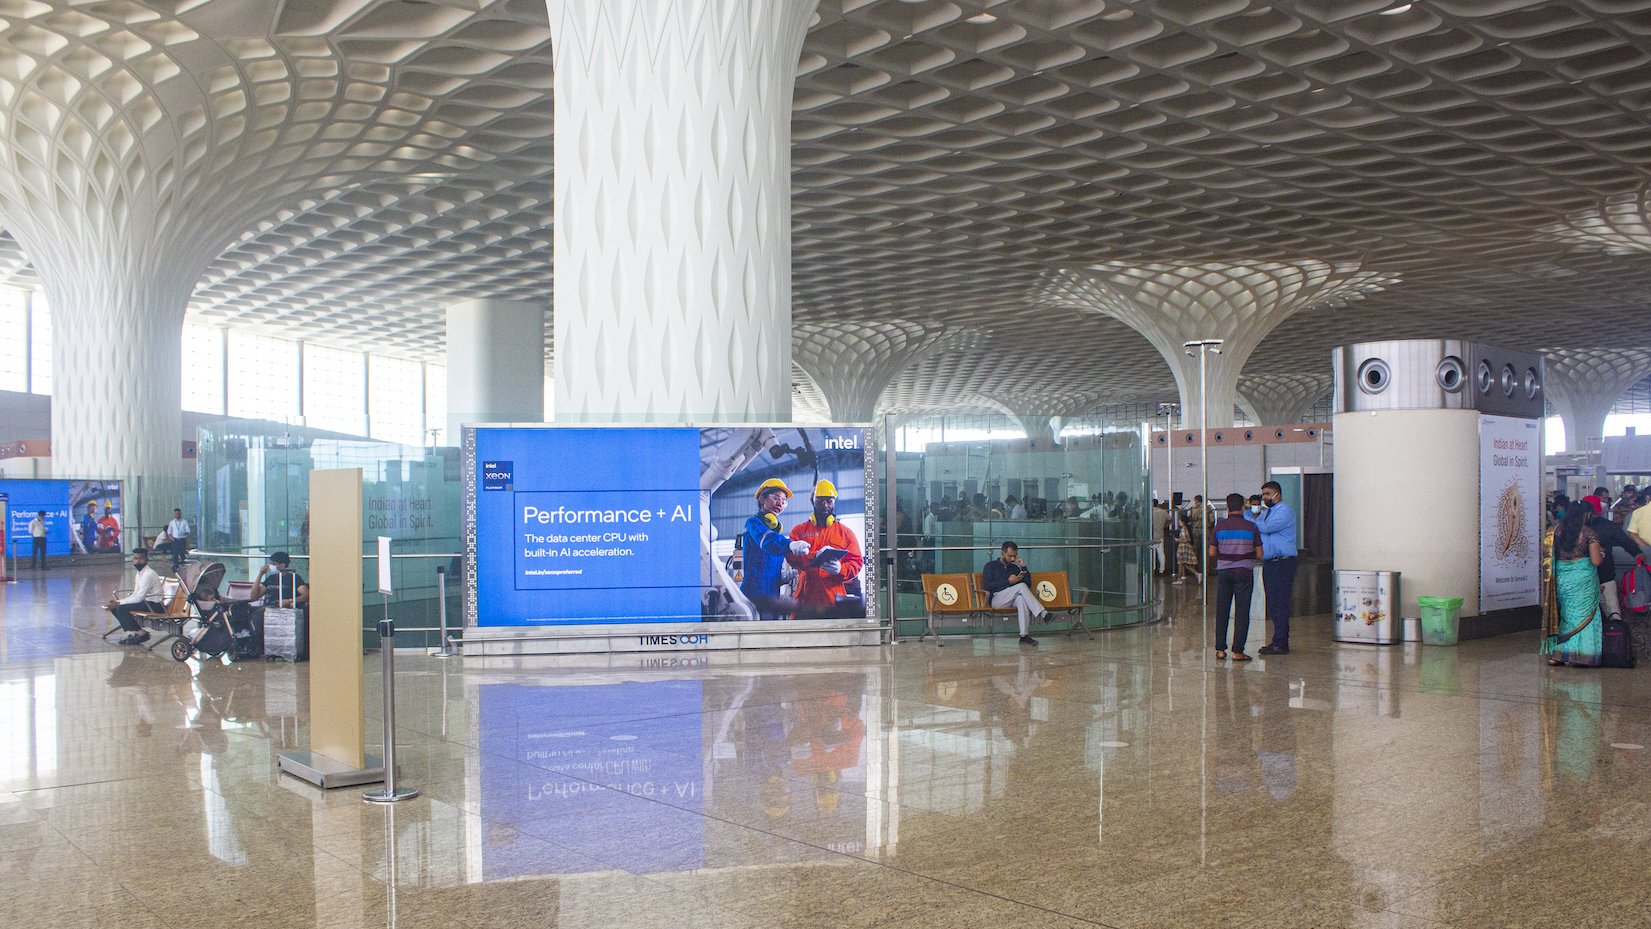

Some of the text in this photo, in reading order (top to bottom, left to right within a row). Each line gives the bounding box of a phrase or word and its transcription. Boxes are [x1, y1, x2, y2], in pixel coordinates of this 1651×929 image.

[1493, 437, 1508, 450] Indian
[1515, 439, 1528, 451] Heart
[1493, 454, 1508, 467] Global
[368, 496, 396, 511] Indian
[409, 497, 432, 511] Heart
[11, 510, 54, 519] Performce
[523, 504, 692, 524] Performance + AI
[368, 514, 397, 529] Global
[524, 532, 649, 543] The data center CPU with
[524, 547, 635, 558] built-in AI acceleration.
[524, 568, 583, 576] intel.in/xeonpreferred
[639, 635, 677, 646] TIMES
